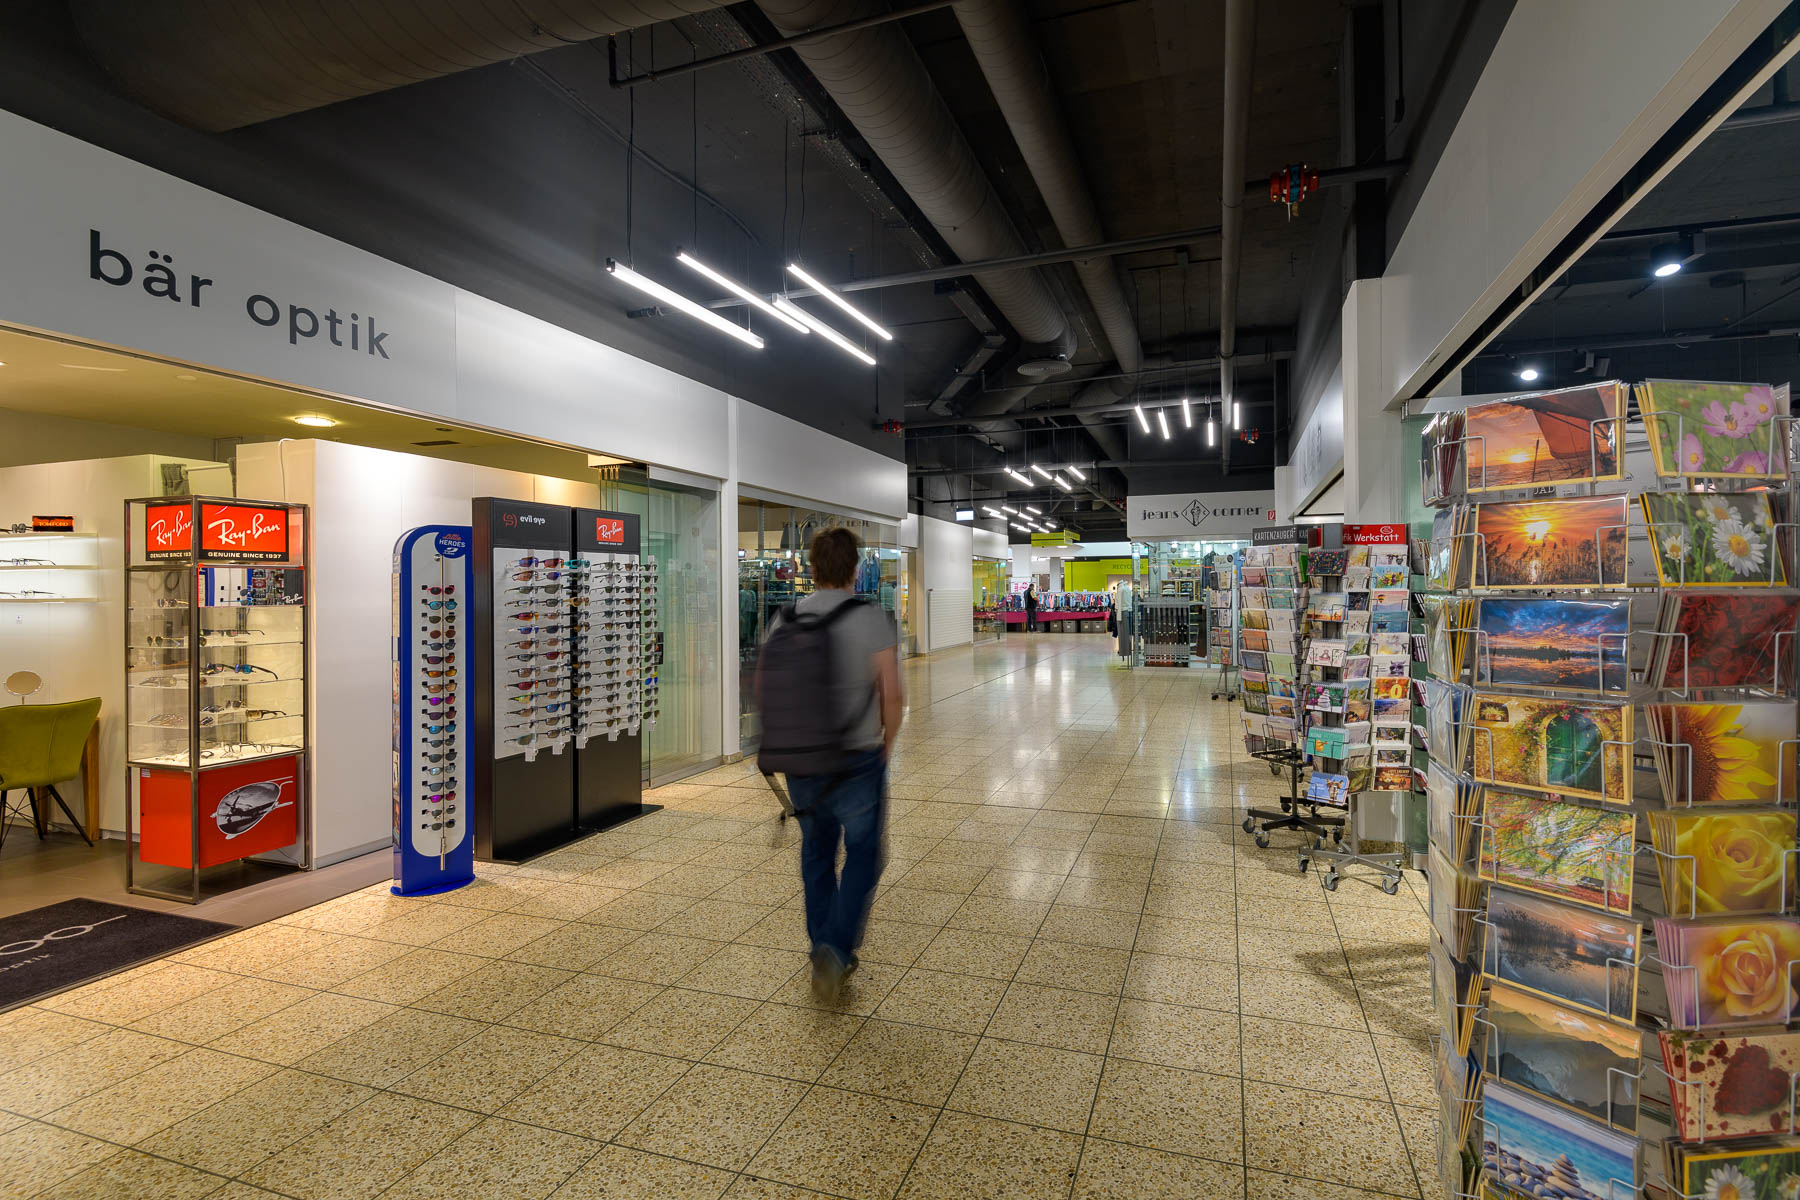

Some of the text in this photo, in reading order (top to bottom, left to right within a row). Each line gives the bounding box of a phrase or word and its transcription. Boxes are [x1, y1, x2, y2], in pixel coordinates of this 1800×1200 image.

[89, 228, 391, 359] bär optik
[1142, 506, 1263, 521] jeans corner
[520, 515, 533, 523] evil
[1353, 533, 1399, 542] Werkstatt
[439, 539, 466, 548] HEROES
